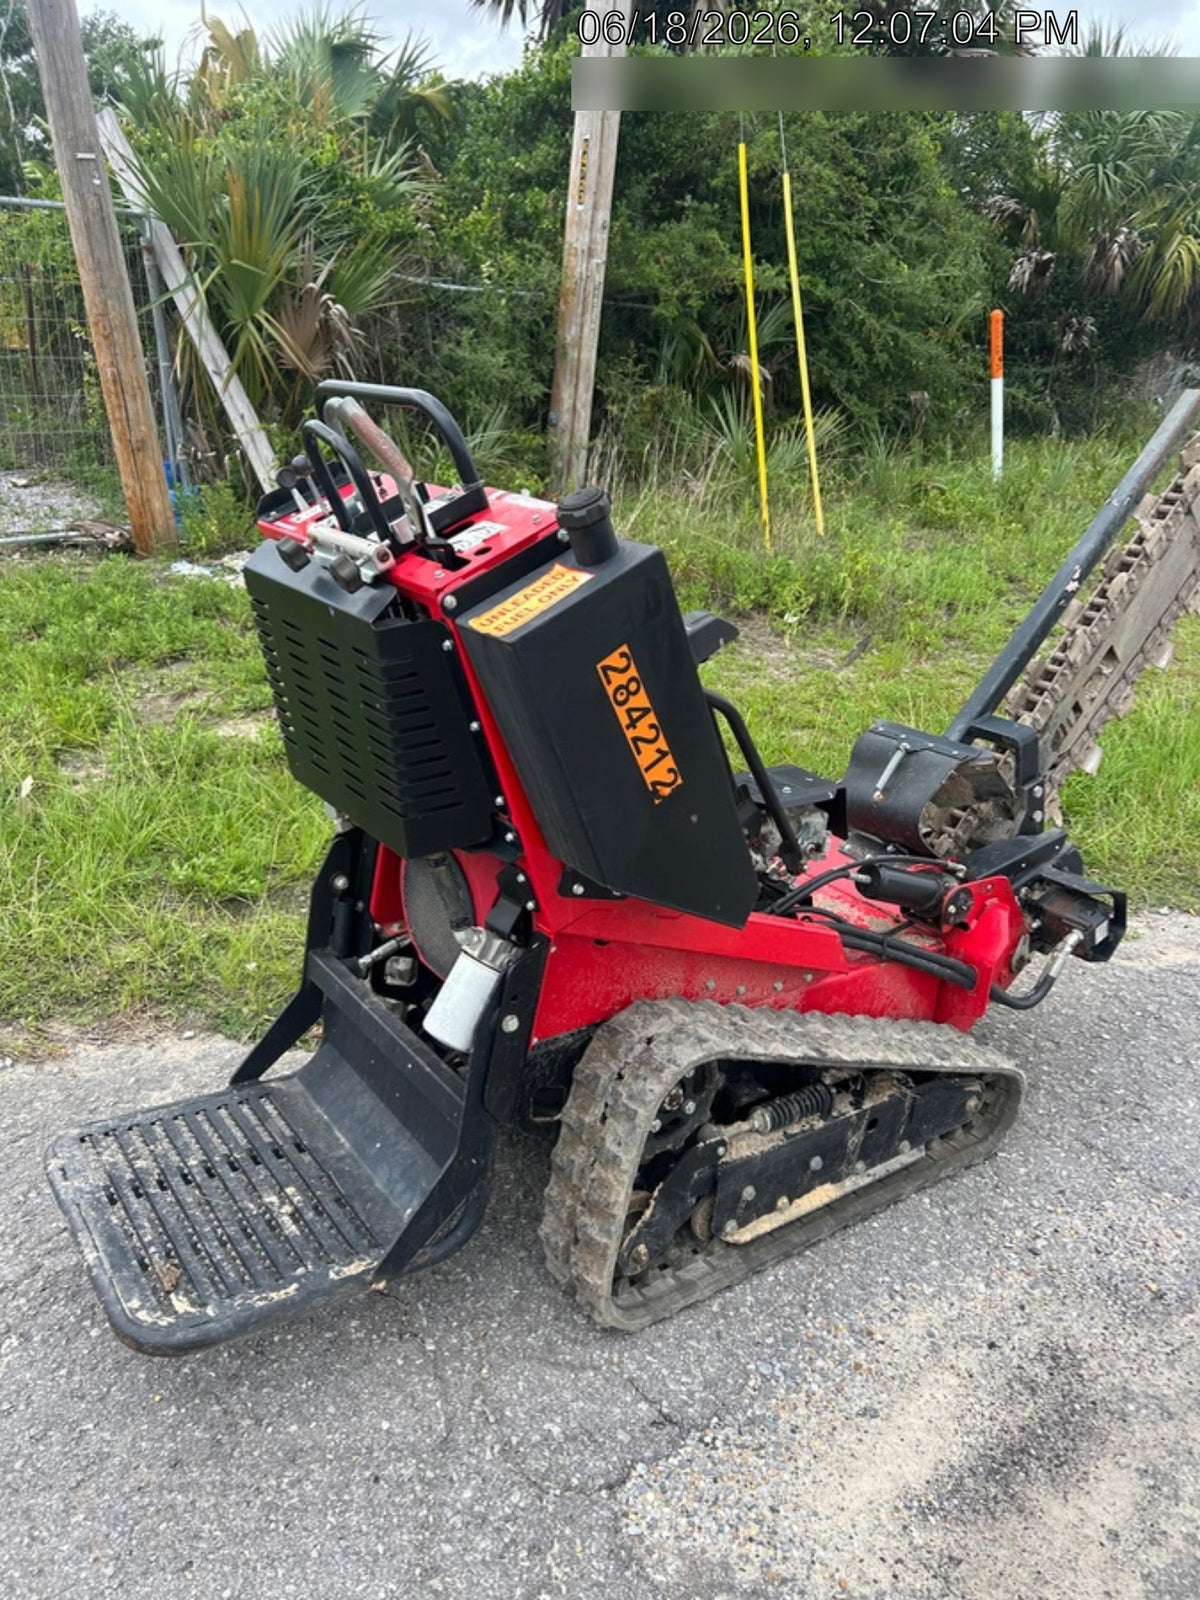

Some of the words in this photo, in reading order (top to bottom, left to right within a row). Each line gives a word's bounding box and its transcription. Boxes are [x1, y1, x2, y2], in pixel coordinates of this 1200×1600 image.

[479, 571, 565, 628] UNLEADED
[494, 605, 540, 632] FUEL
[538, 575, 579, 604] ONLY
[600, 651, 679, 799] 284212
